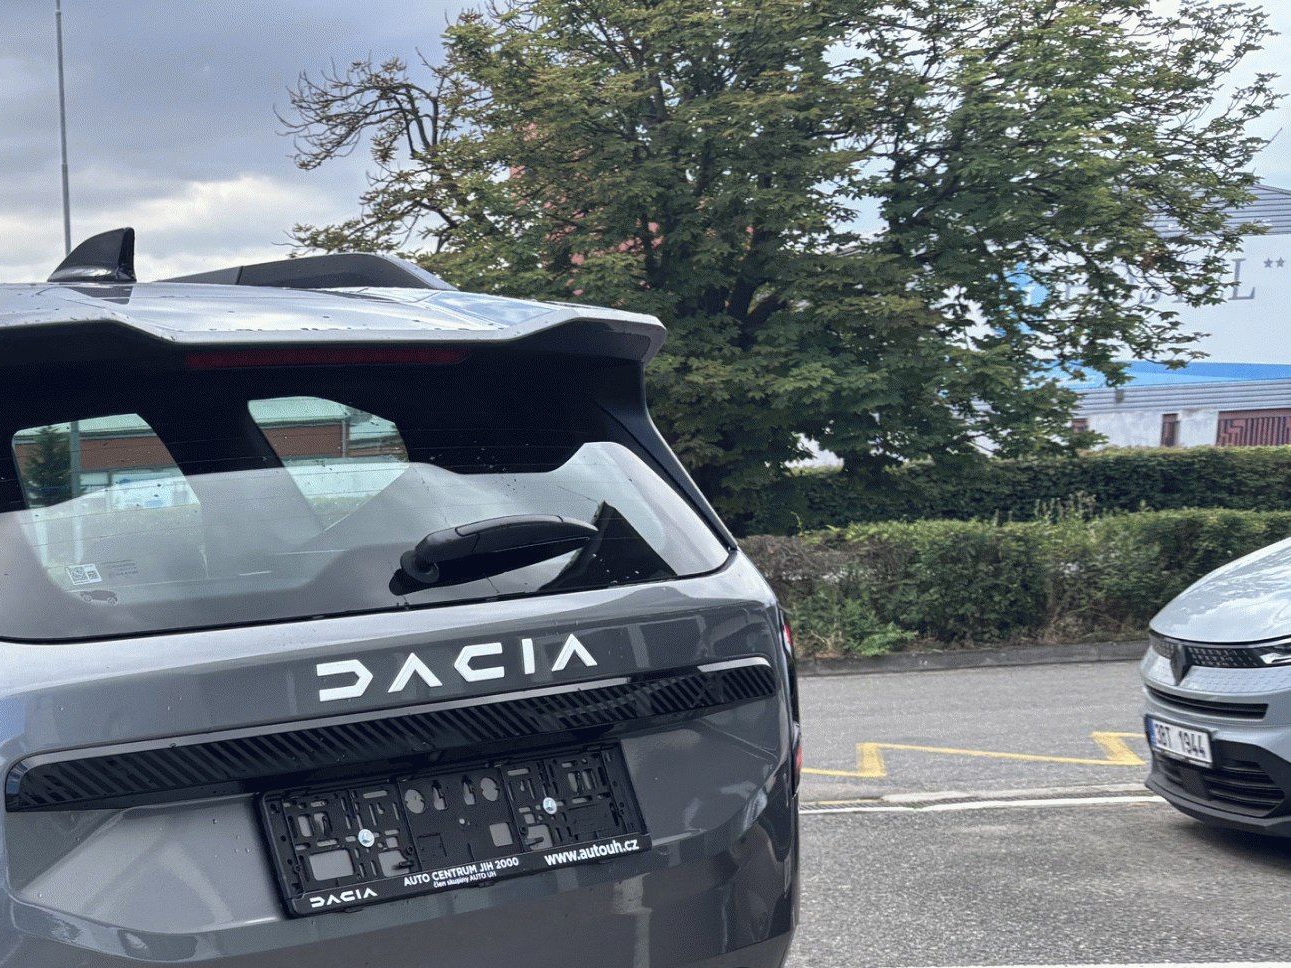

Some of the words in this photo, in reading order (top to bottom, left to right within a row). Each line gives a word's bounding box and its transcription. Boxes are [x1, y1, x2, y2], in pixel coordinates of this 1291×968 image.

[316, 633, 598, 702] DACIA
[1179, 730, 1207, 758] 1944
[544, 838, 640, 866] www.autouh.cz
[403, 872, 430, 887] AUTO
[431, 864, 477, 881] CENTRUM
[479, 860, 494, 873] JIH
[494, 857, 520, 870] 2000
[447, 875, 470, 887] skupiny
[469, 873, 487, 883] AUTO
[487, 870, 497, 879] UH
[310, 887, 378, 908] DACIA
